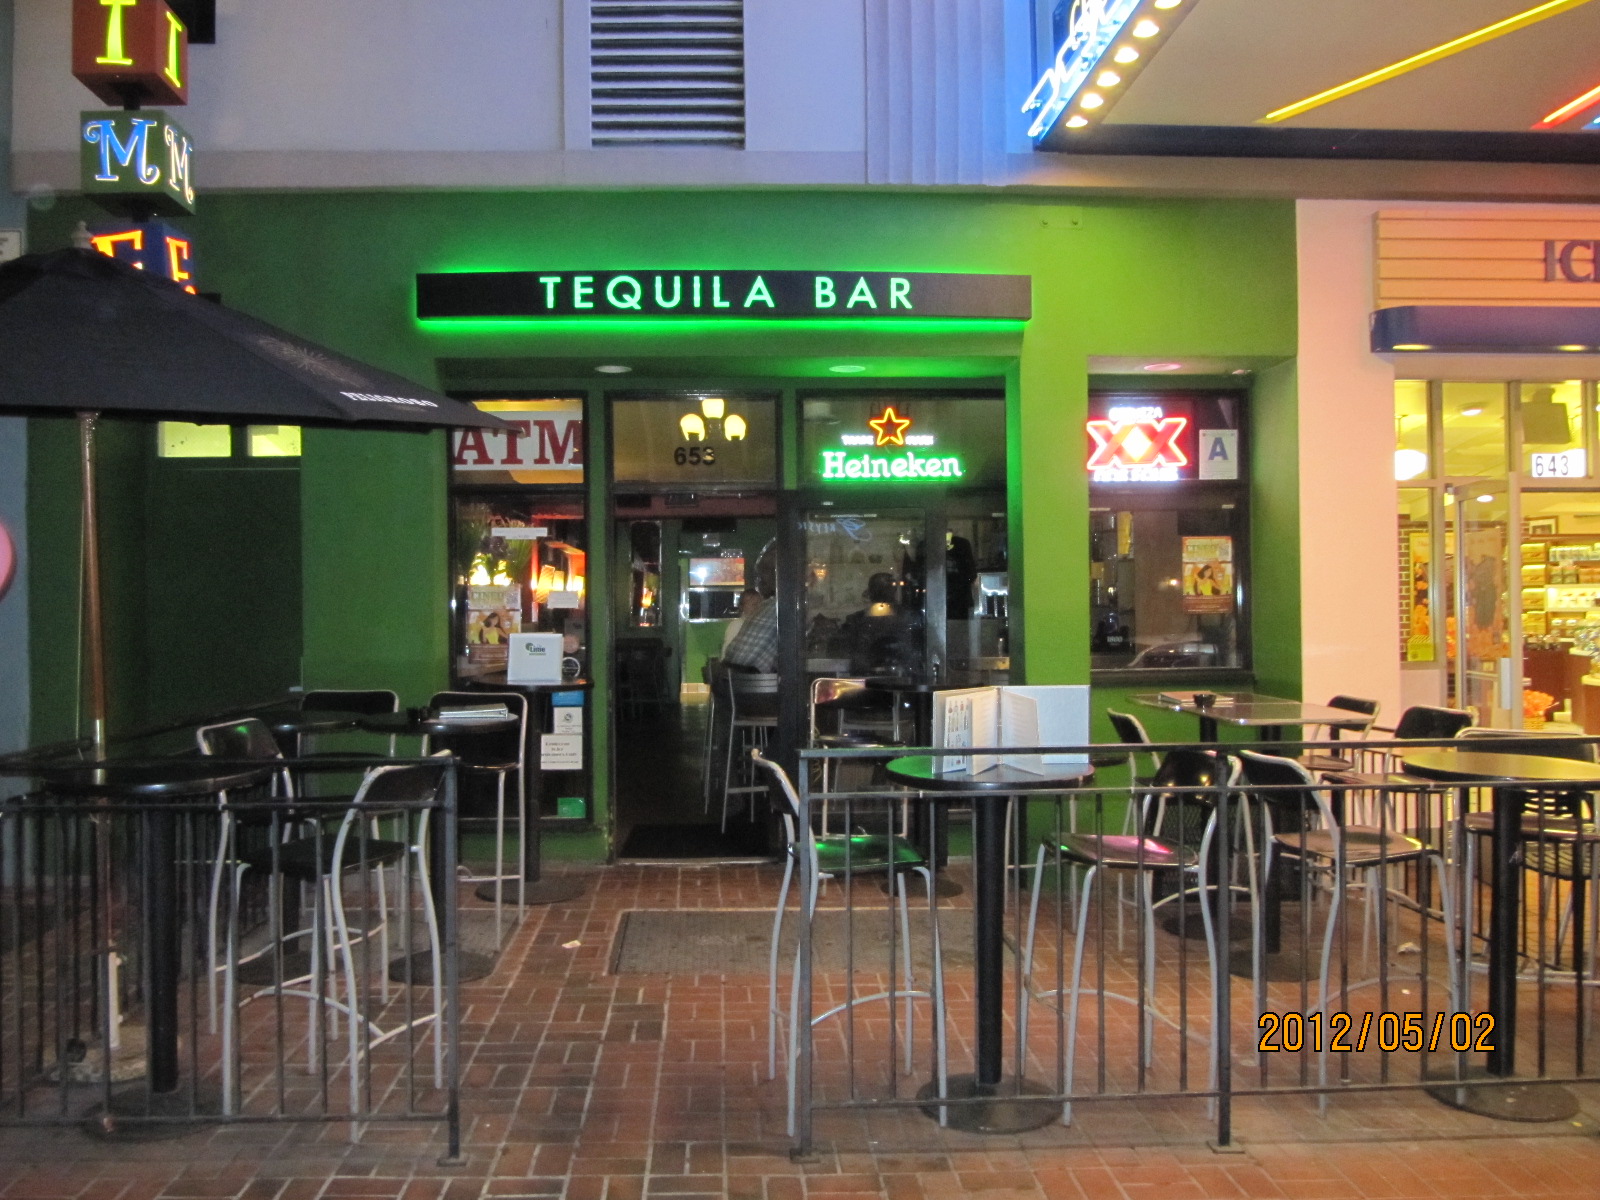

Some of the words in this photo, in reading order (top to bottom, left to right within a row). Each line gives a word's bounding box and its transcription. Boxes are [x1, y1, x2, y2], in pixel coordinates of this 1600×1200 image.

[539, 275, 775, 309] TEQUILA
[815, 276, 912, 309] BAR
[453, 419, 583, 465] ATM
[1208, 437, 1229, 461] A
[674, 447, 716, 465] 653
[822, 451, 963, 479] Heineken
[1535, 455, 1569, 477] 643
